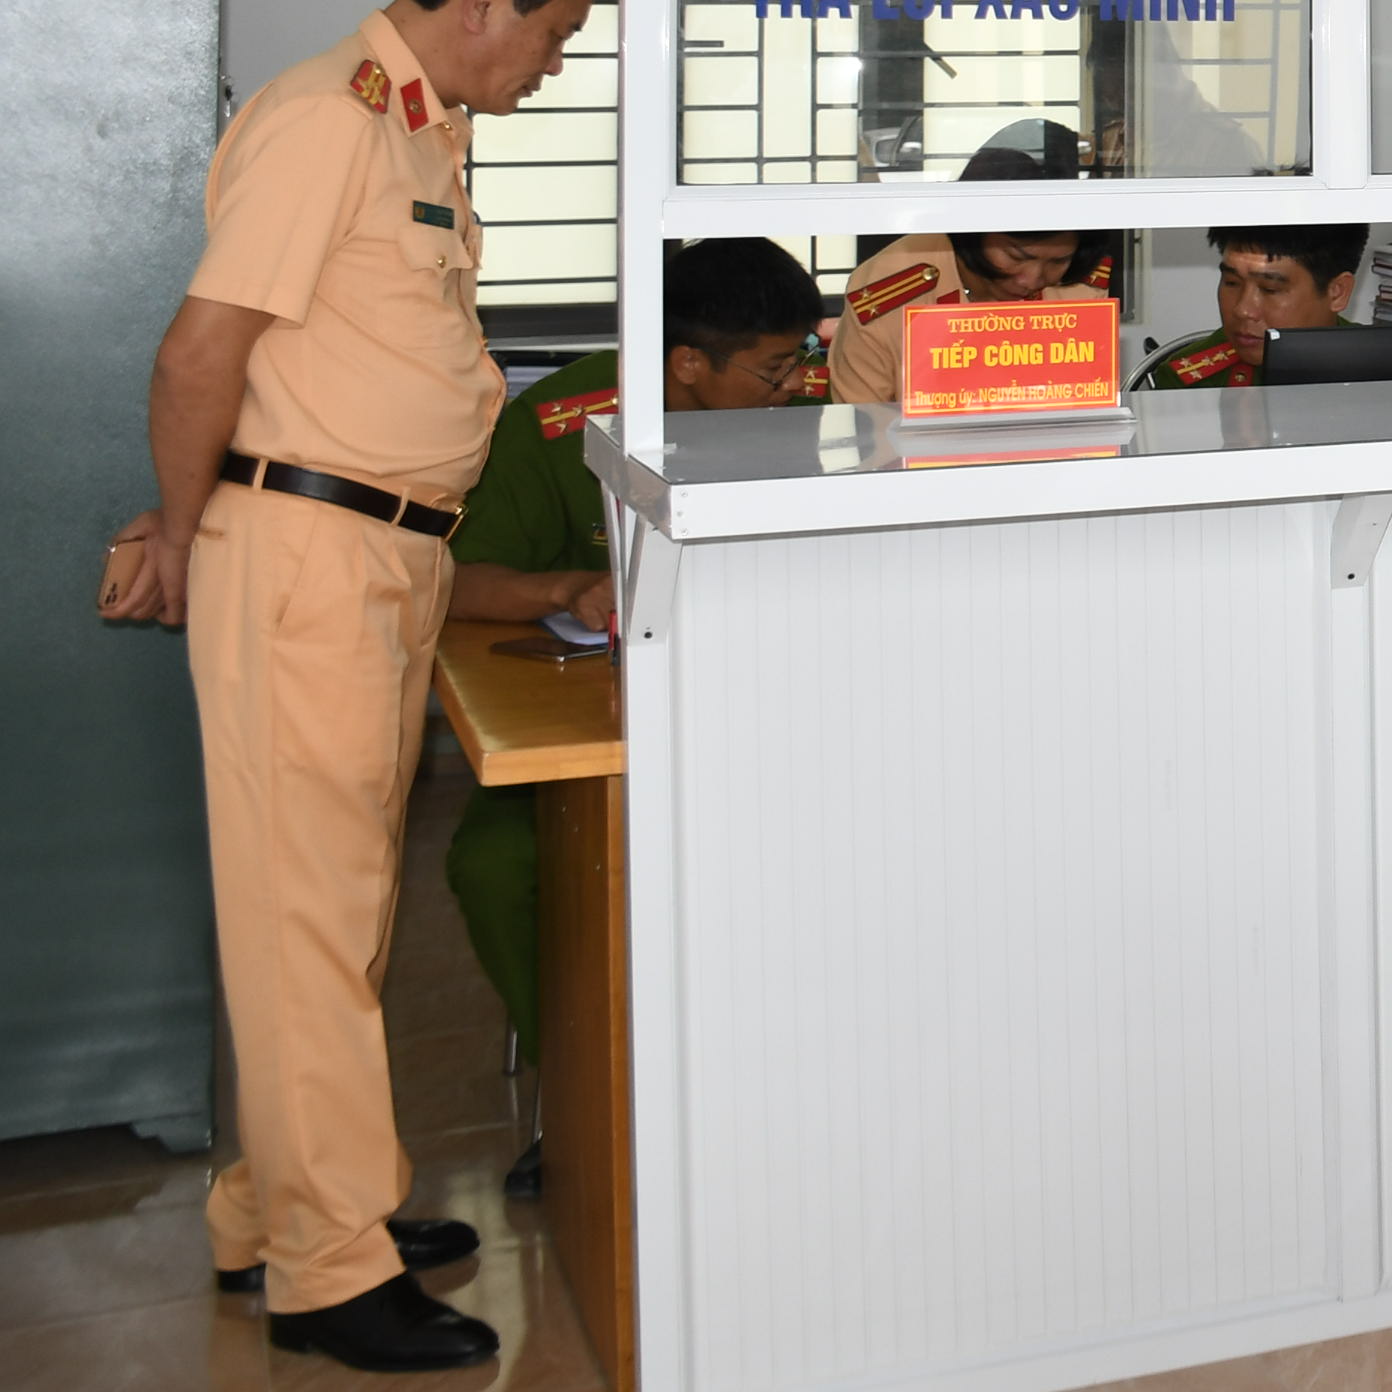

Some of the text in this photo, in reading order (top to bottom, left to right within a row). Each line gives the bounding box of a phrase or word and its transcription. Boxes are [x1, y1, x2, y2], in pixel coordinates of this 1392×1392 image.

[947, 312, 1078, 334] THƯỜNG TRỰC
[929, 337, 1095, 370] TIẾP CÔNG DÂN
[915, 390, 956, 409] Thượng
[1074, 377, 1109, 399] CHIẾN
